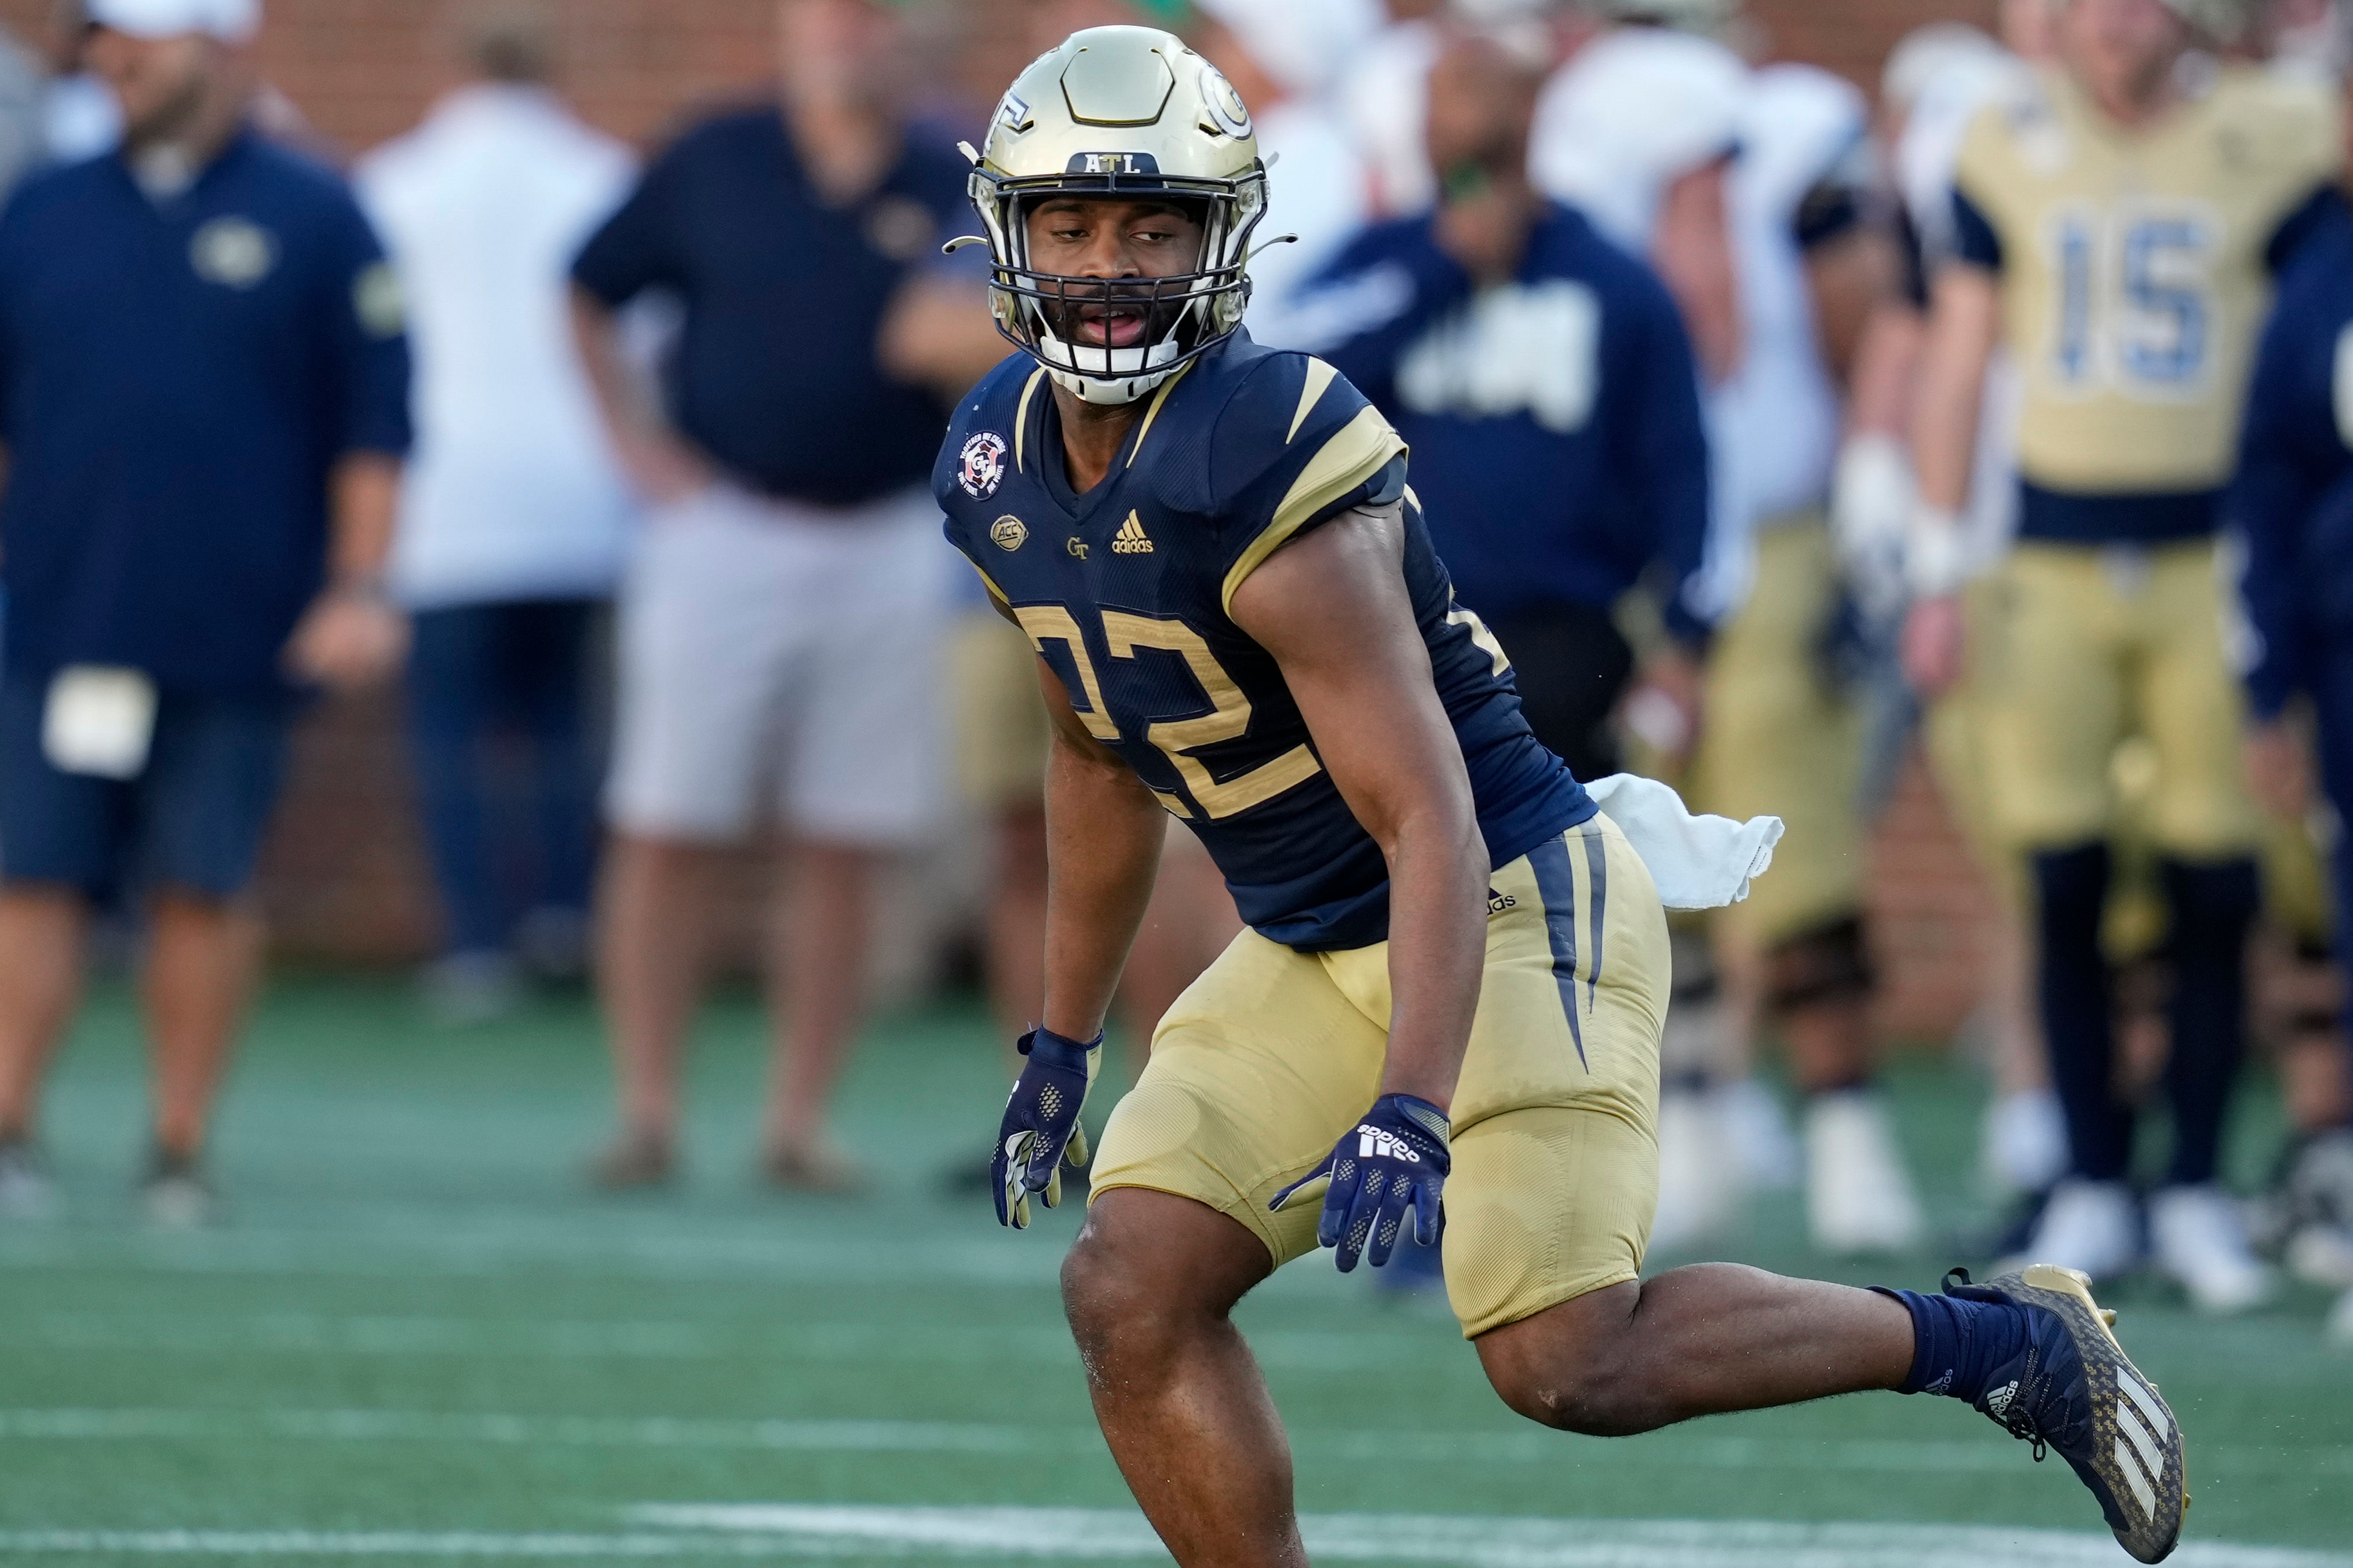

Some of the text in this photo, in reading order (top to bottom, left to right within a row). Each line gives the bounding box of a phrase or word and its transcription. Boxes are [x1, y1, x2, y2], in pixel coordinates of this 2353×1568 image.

[1084, 153, 1141, 174] ATL
[2048, 207, 2218, 392] 15
[997, 524, 1019, 539] ACC
[1067, 536, 1089, 561] GT
[1111, 537, 1154, 554] adidas
[1356, 1124, 1421, 1163] adidas
